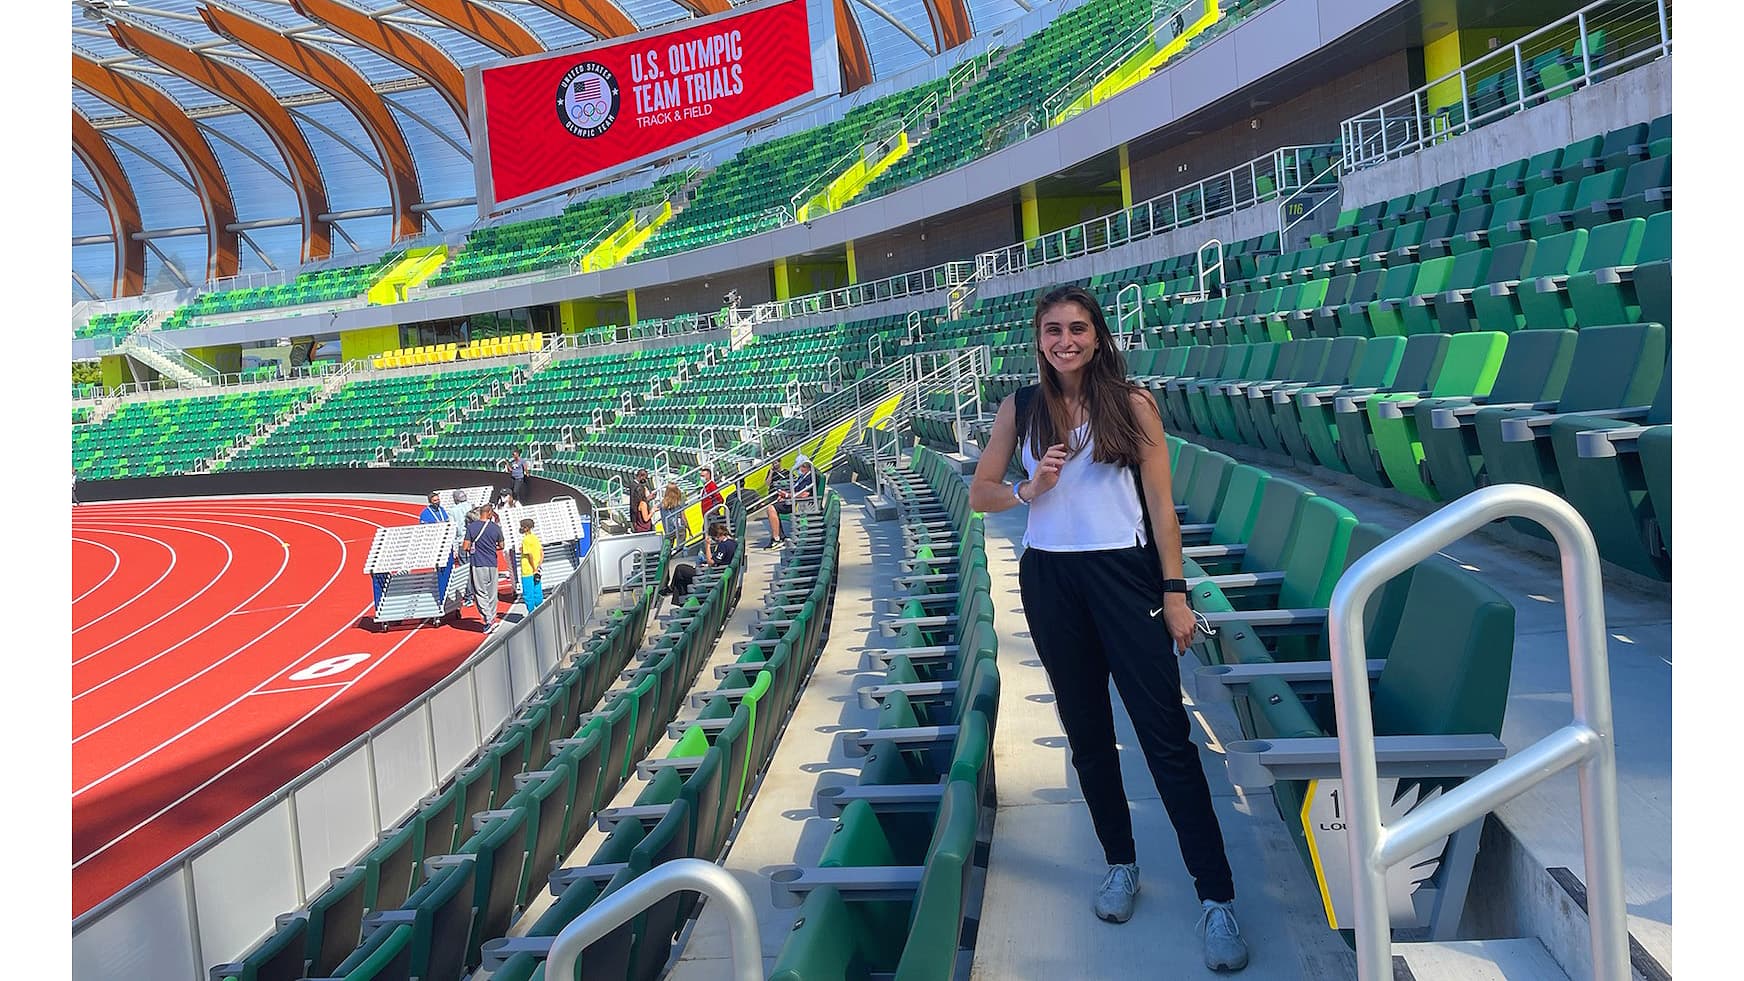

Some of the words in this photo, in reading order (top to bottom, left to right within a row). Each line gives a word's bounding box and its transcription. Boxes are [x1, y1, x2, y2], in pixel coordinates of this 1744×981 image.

[630, 50, 664, 83] U.S.
[668, 30, 743, 75] OLYMPIC
[561, 65, 584, 88] UNITED
[586, 63, 612, 80] STATES
[633, 77, 680, 115] TEAM
[684, 63, 744, 105] TRIALS
[565, 121, 595, 137] OLYMPIC
[597, 114, 615, 134] TEAM
[636, 111, 672, 128] TRACK
[673, 110, 681, 122] &
[683, 104, 713, 119] FIELD
[1288, 203, 1304, 215] 116
[288, 652, 372, 681] 8
